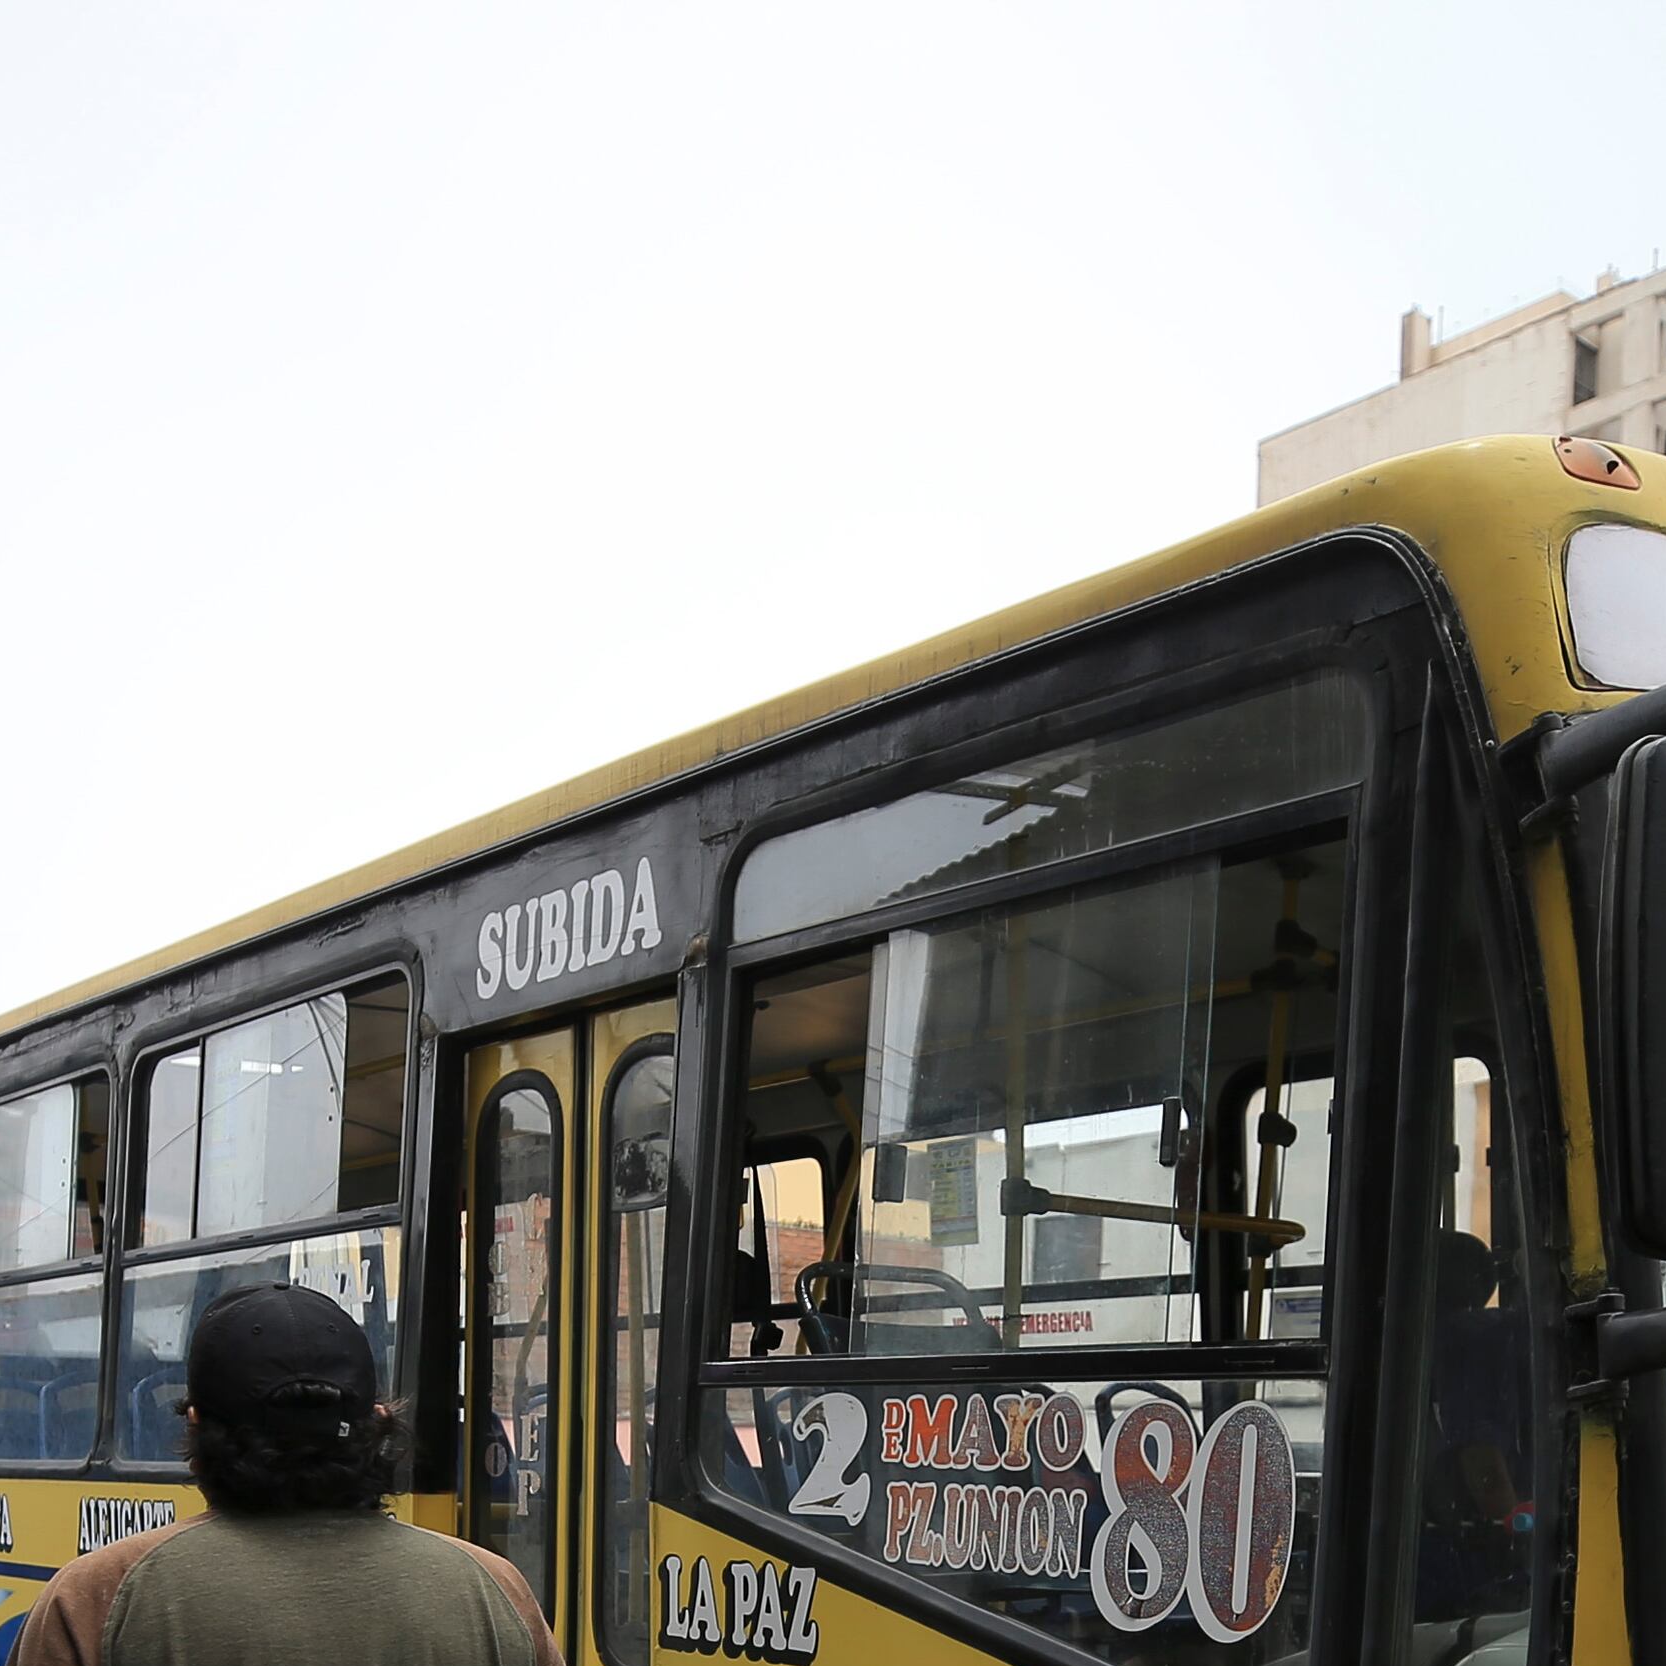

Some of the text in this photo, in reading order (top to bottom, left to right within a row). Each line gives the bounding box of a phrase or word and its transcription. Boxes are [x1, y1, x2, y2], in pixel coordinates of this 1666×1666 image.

[477, 857, 662, 999] SUBIDA
[788, 1392, 871, 1527] 2
[906, 1392, 1087, 1472] MAYO
[1090, 1399, 1296, 1643] 80
[663, 1556, 820, 1661] LA PAZ
